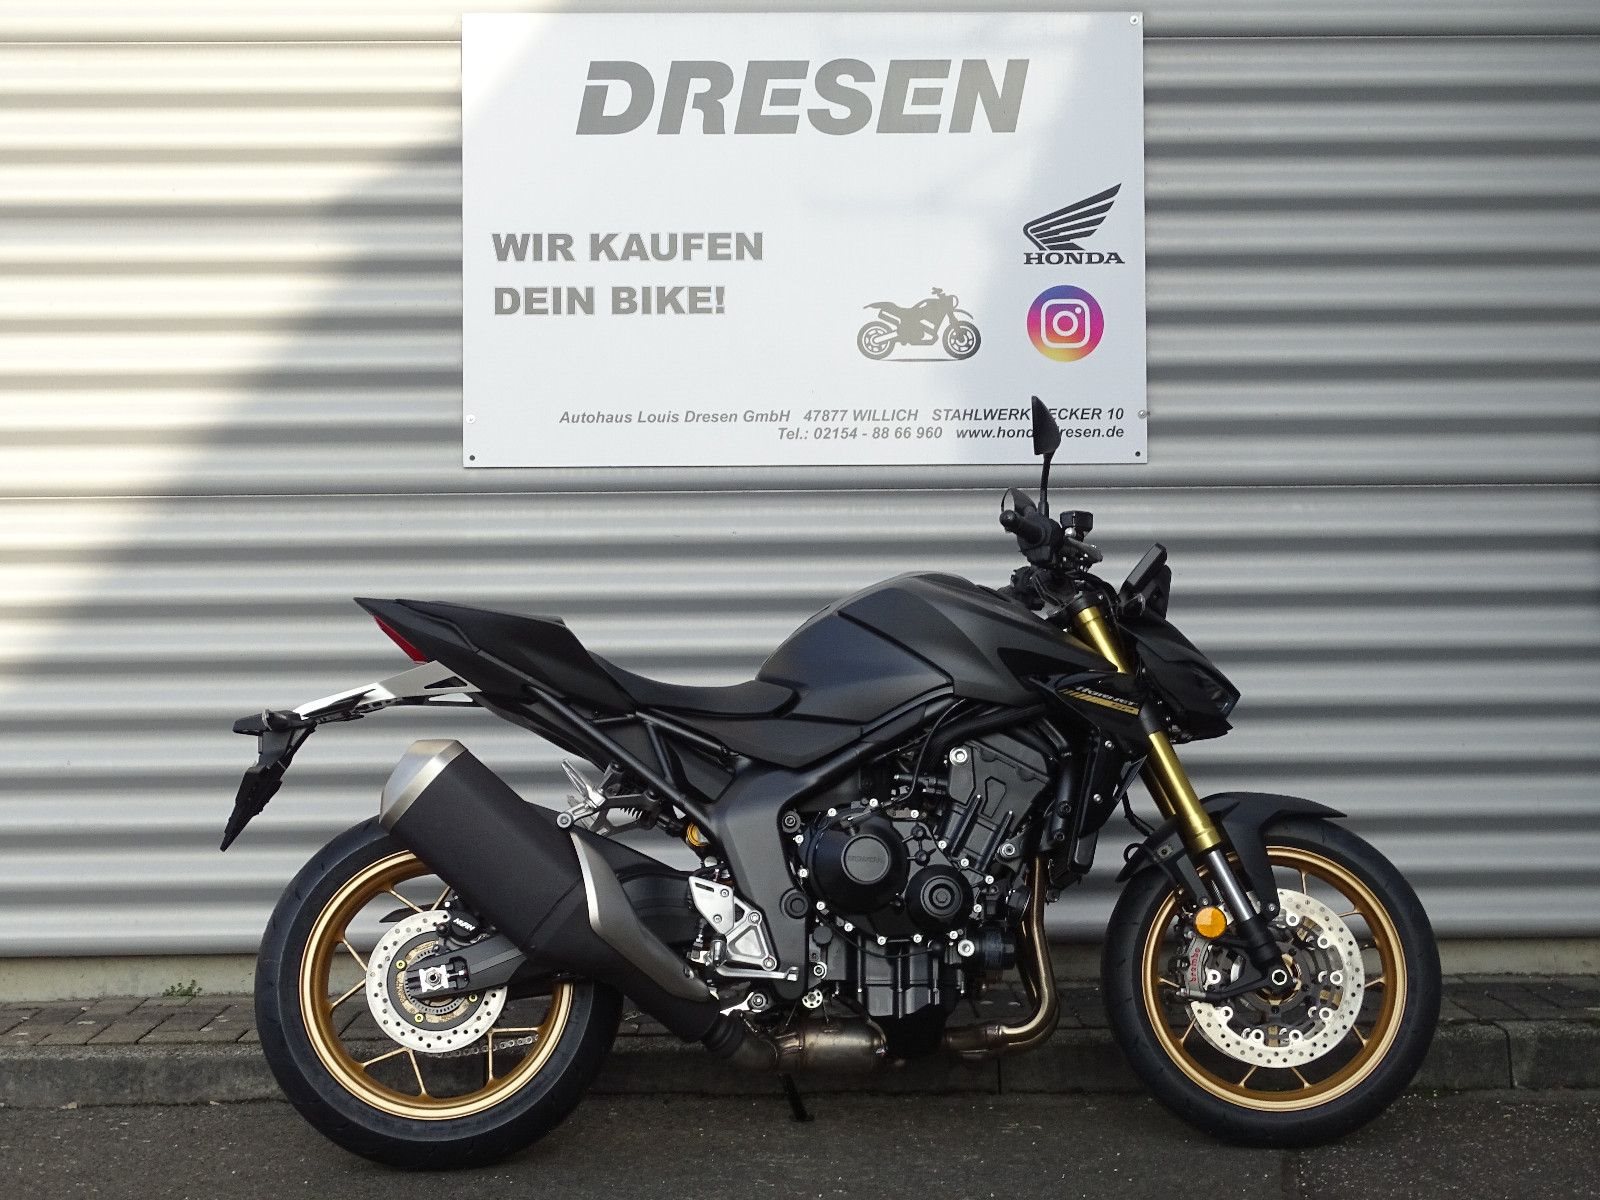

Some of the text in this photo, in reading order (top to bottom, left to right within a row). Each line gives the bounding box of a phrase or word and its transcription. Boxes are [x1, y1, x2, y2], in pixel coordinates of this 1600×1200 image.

[576, 59, 1029, 135] DRESEN
[492, 232, 763, 262] WIR KAUFEN
[1024, 252, 1125, 265] HONDA
[494, 286, 725, 315] DEIN BIKE!
[559, 408, 1124, 424] Autohaus Louis Dresen GmbH 47877 WILLICH STAHLWERK ECKER 10
[778, 427, 808, 440] Tel.:
[813, 427, 857, 440] 02154
[872, 427, 890, 440] 88
[894, 427, 912, 439] 66
[916, 427, 943, 439] 960
